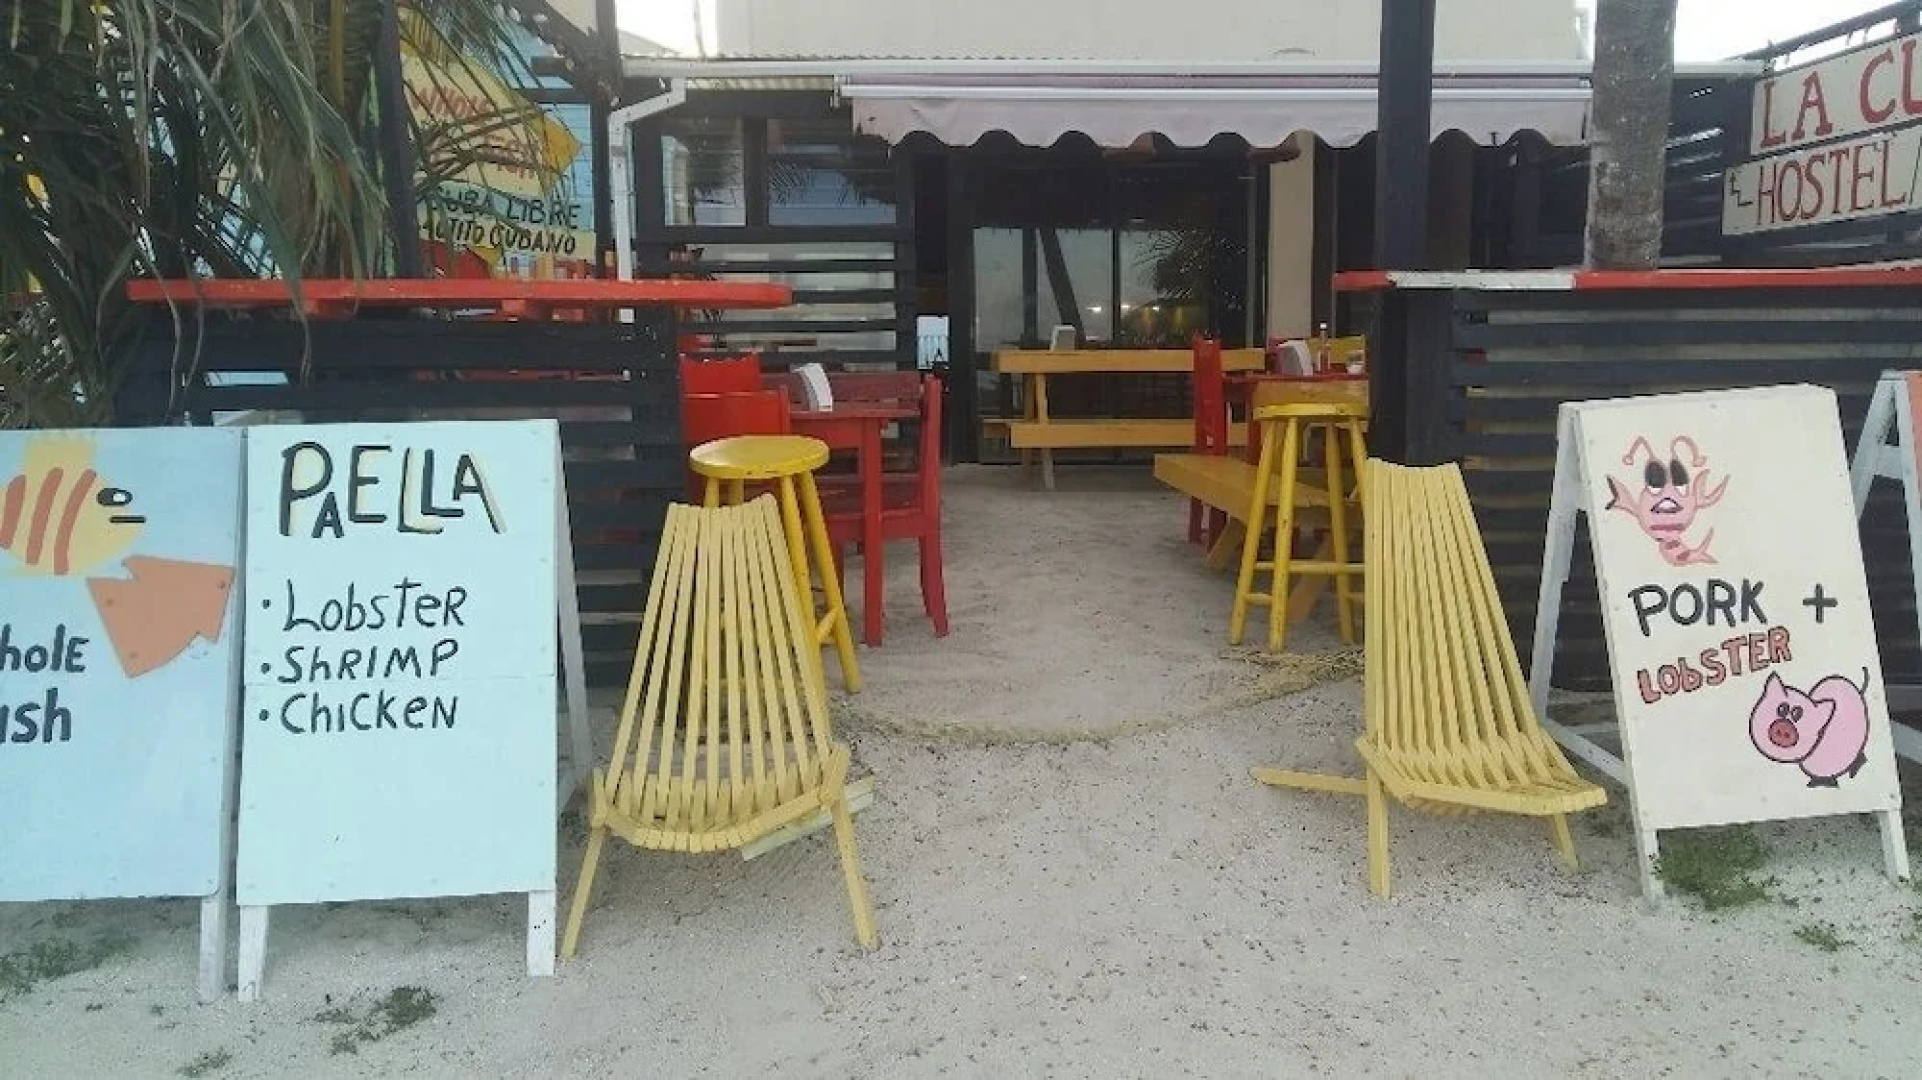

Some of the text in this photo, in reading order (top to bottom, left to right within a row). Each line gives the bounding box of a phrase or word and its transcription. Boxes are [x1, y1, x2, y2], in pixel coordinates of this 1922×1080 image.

[1760, 70, 1833, 148] LA
[507, 199, 581, 230] LIBRE
[1757, 139, 1907, 226] HOSTEL
[489, 221, 577, 254] CUBANO
[279, 440, 507, 538] PAELLA
[1628, 578, 1838, 637] PORK +
